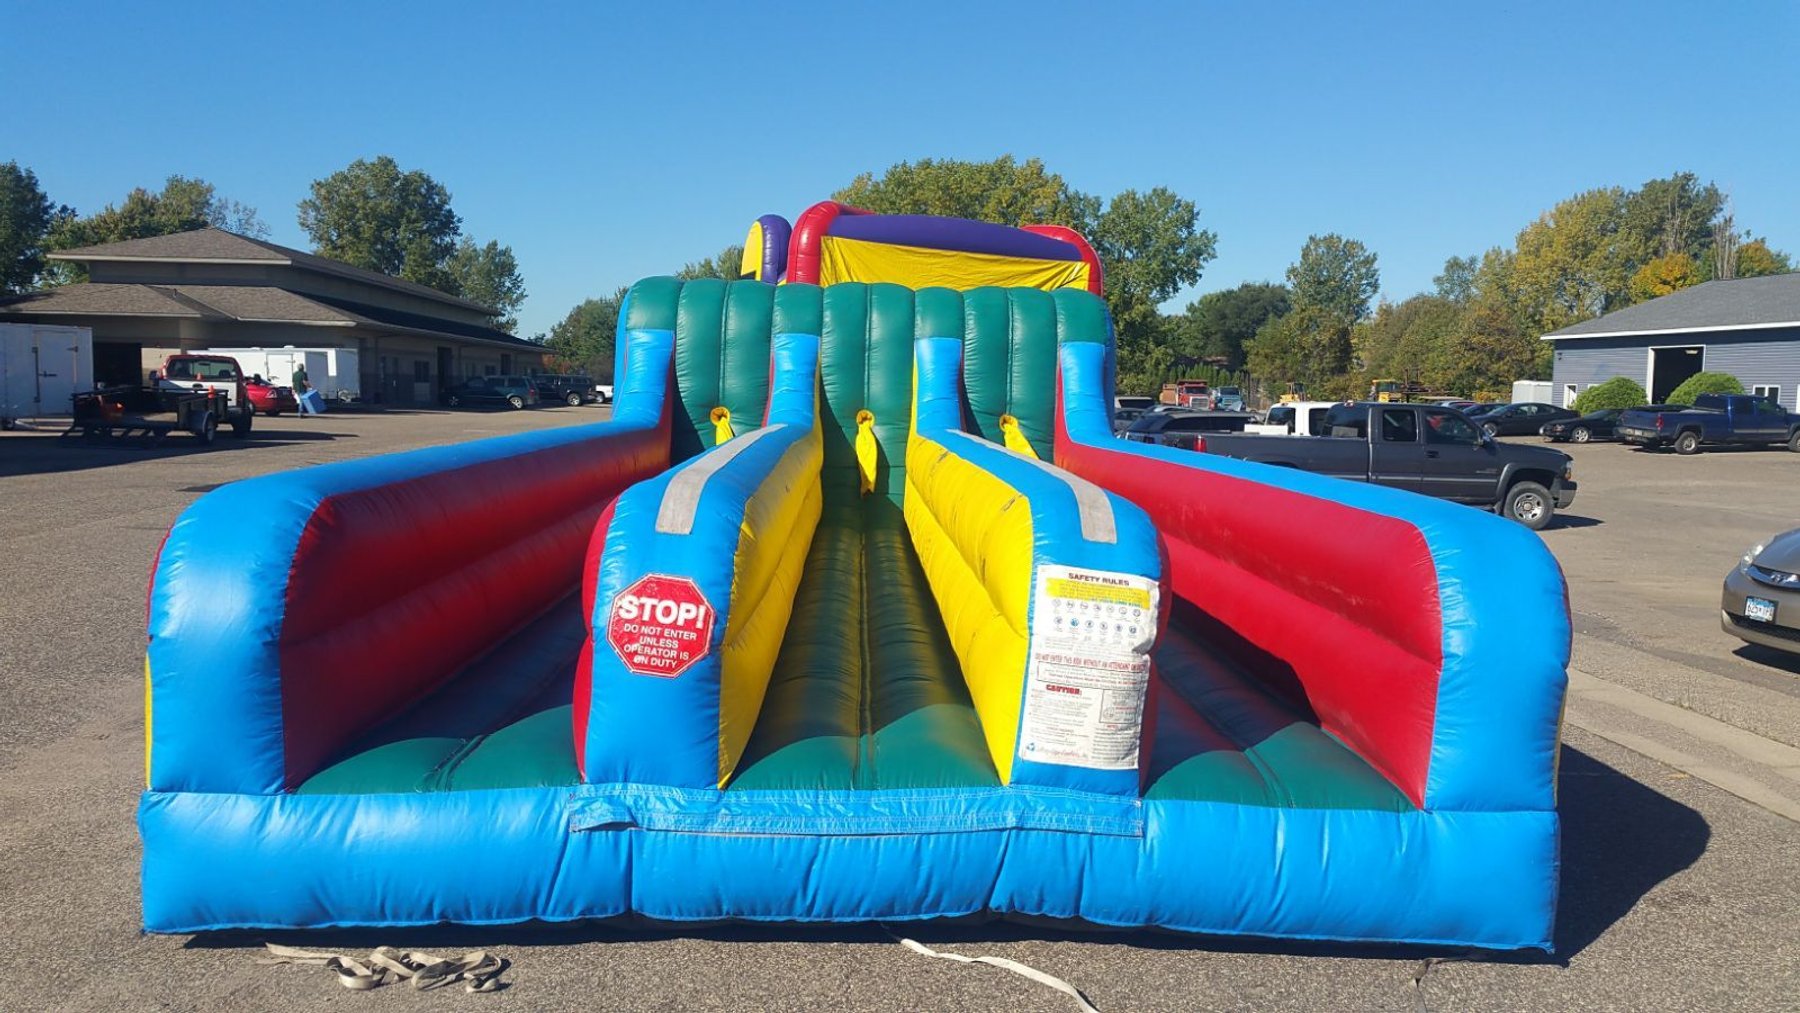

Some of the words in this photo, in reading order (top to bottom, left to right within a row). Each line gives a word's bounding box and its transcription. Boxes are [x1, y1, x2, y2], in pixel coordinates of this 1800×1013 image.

[1068, 572, 1100, 582] SAFETY
[1102, 577, 1130, 587] RULES
[618, 594, 707, 629] STOP!
[624, 623, 639, 633] DO
[641, 625, 663, 636] NOT
[664, 628, 698, 641] ENTER
[640, 635, 679, 649] UNLESS
[624, 643, 677, 658] OPERATOR
[680, 651, 690, 660] IS
[650, 657, 678, 669] DUTY
